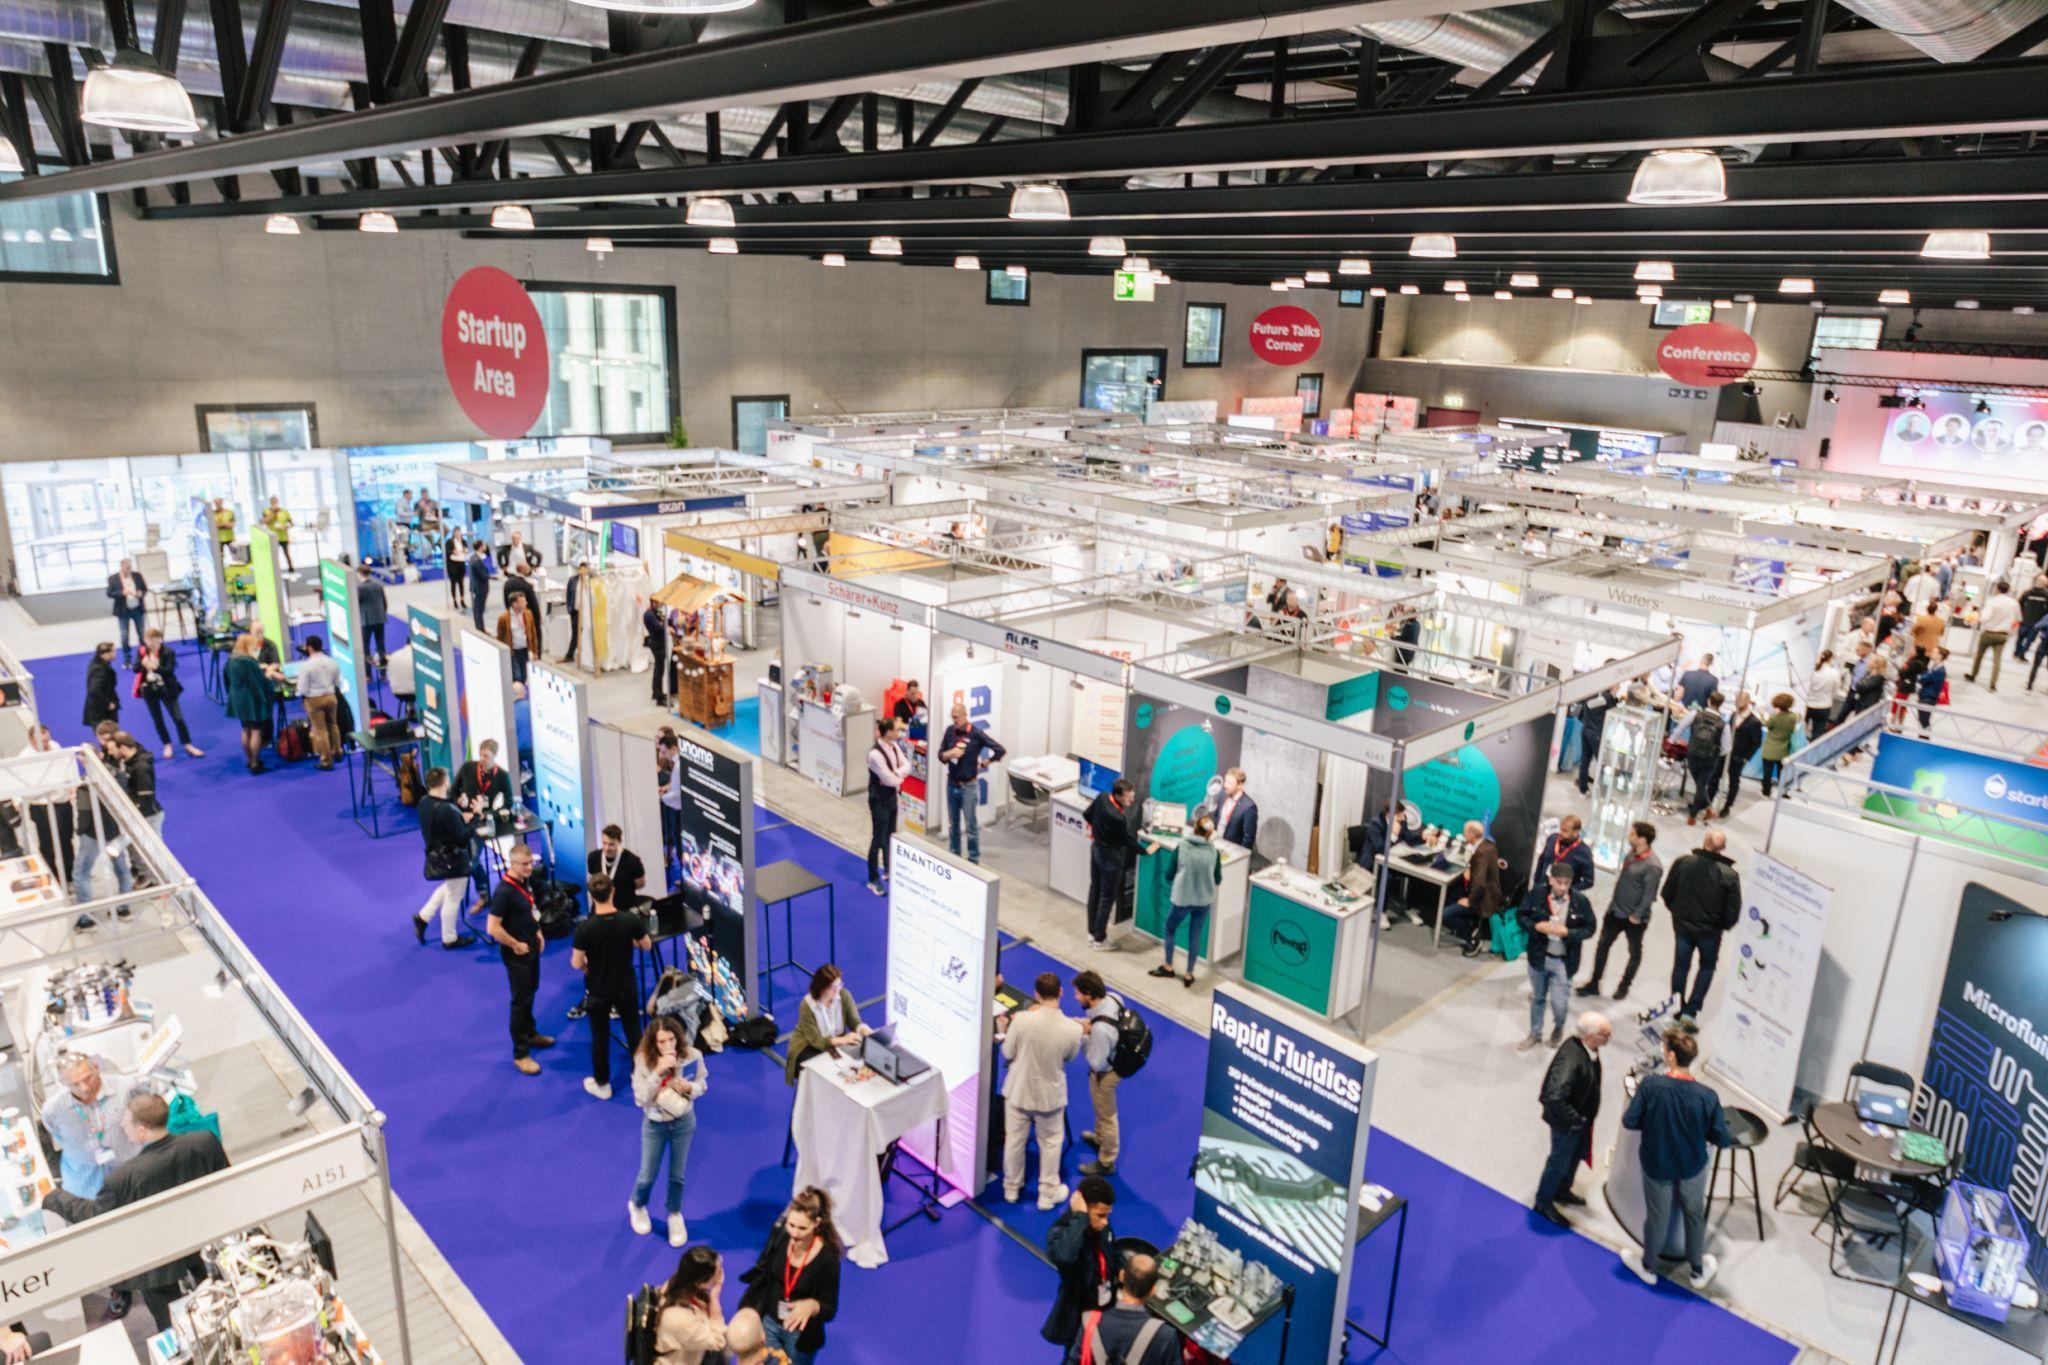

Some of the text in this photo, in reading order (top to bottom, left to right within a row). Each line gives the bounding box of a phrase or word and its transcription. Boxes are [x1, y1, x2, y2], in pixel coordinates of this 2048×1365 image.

[457, 309, 527, 360] Startup
[1252, 322, 1321, 338] Future Talks
[1265, 338, 1304, 353] Corner
[1662, 345, 1752, 363] Conference
[474, 359, 516, 399] Area
[827, 582, 899, 614] Schärer+Kunz
[1423, 777, 1479, 802] Safety valve
[896, 844, 953, 881] ENANTIOS
[1212, 1001, 1362, 1104] Rapid Fluidics
[1227, 1065, 1334, 1132] 3D Printed Microfluidics
[1239, 1083, 1273, 1110] Design
[1236, 1107, 1303, 1154] Manufacturing
[1238, 1095, 1320, 1151] Rapid Prototyping
[302, 1163, 348, 1194] A151
